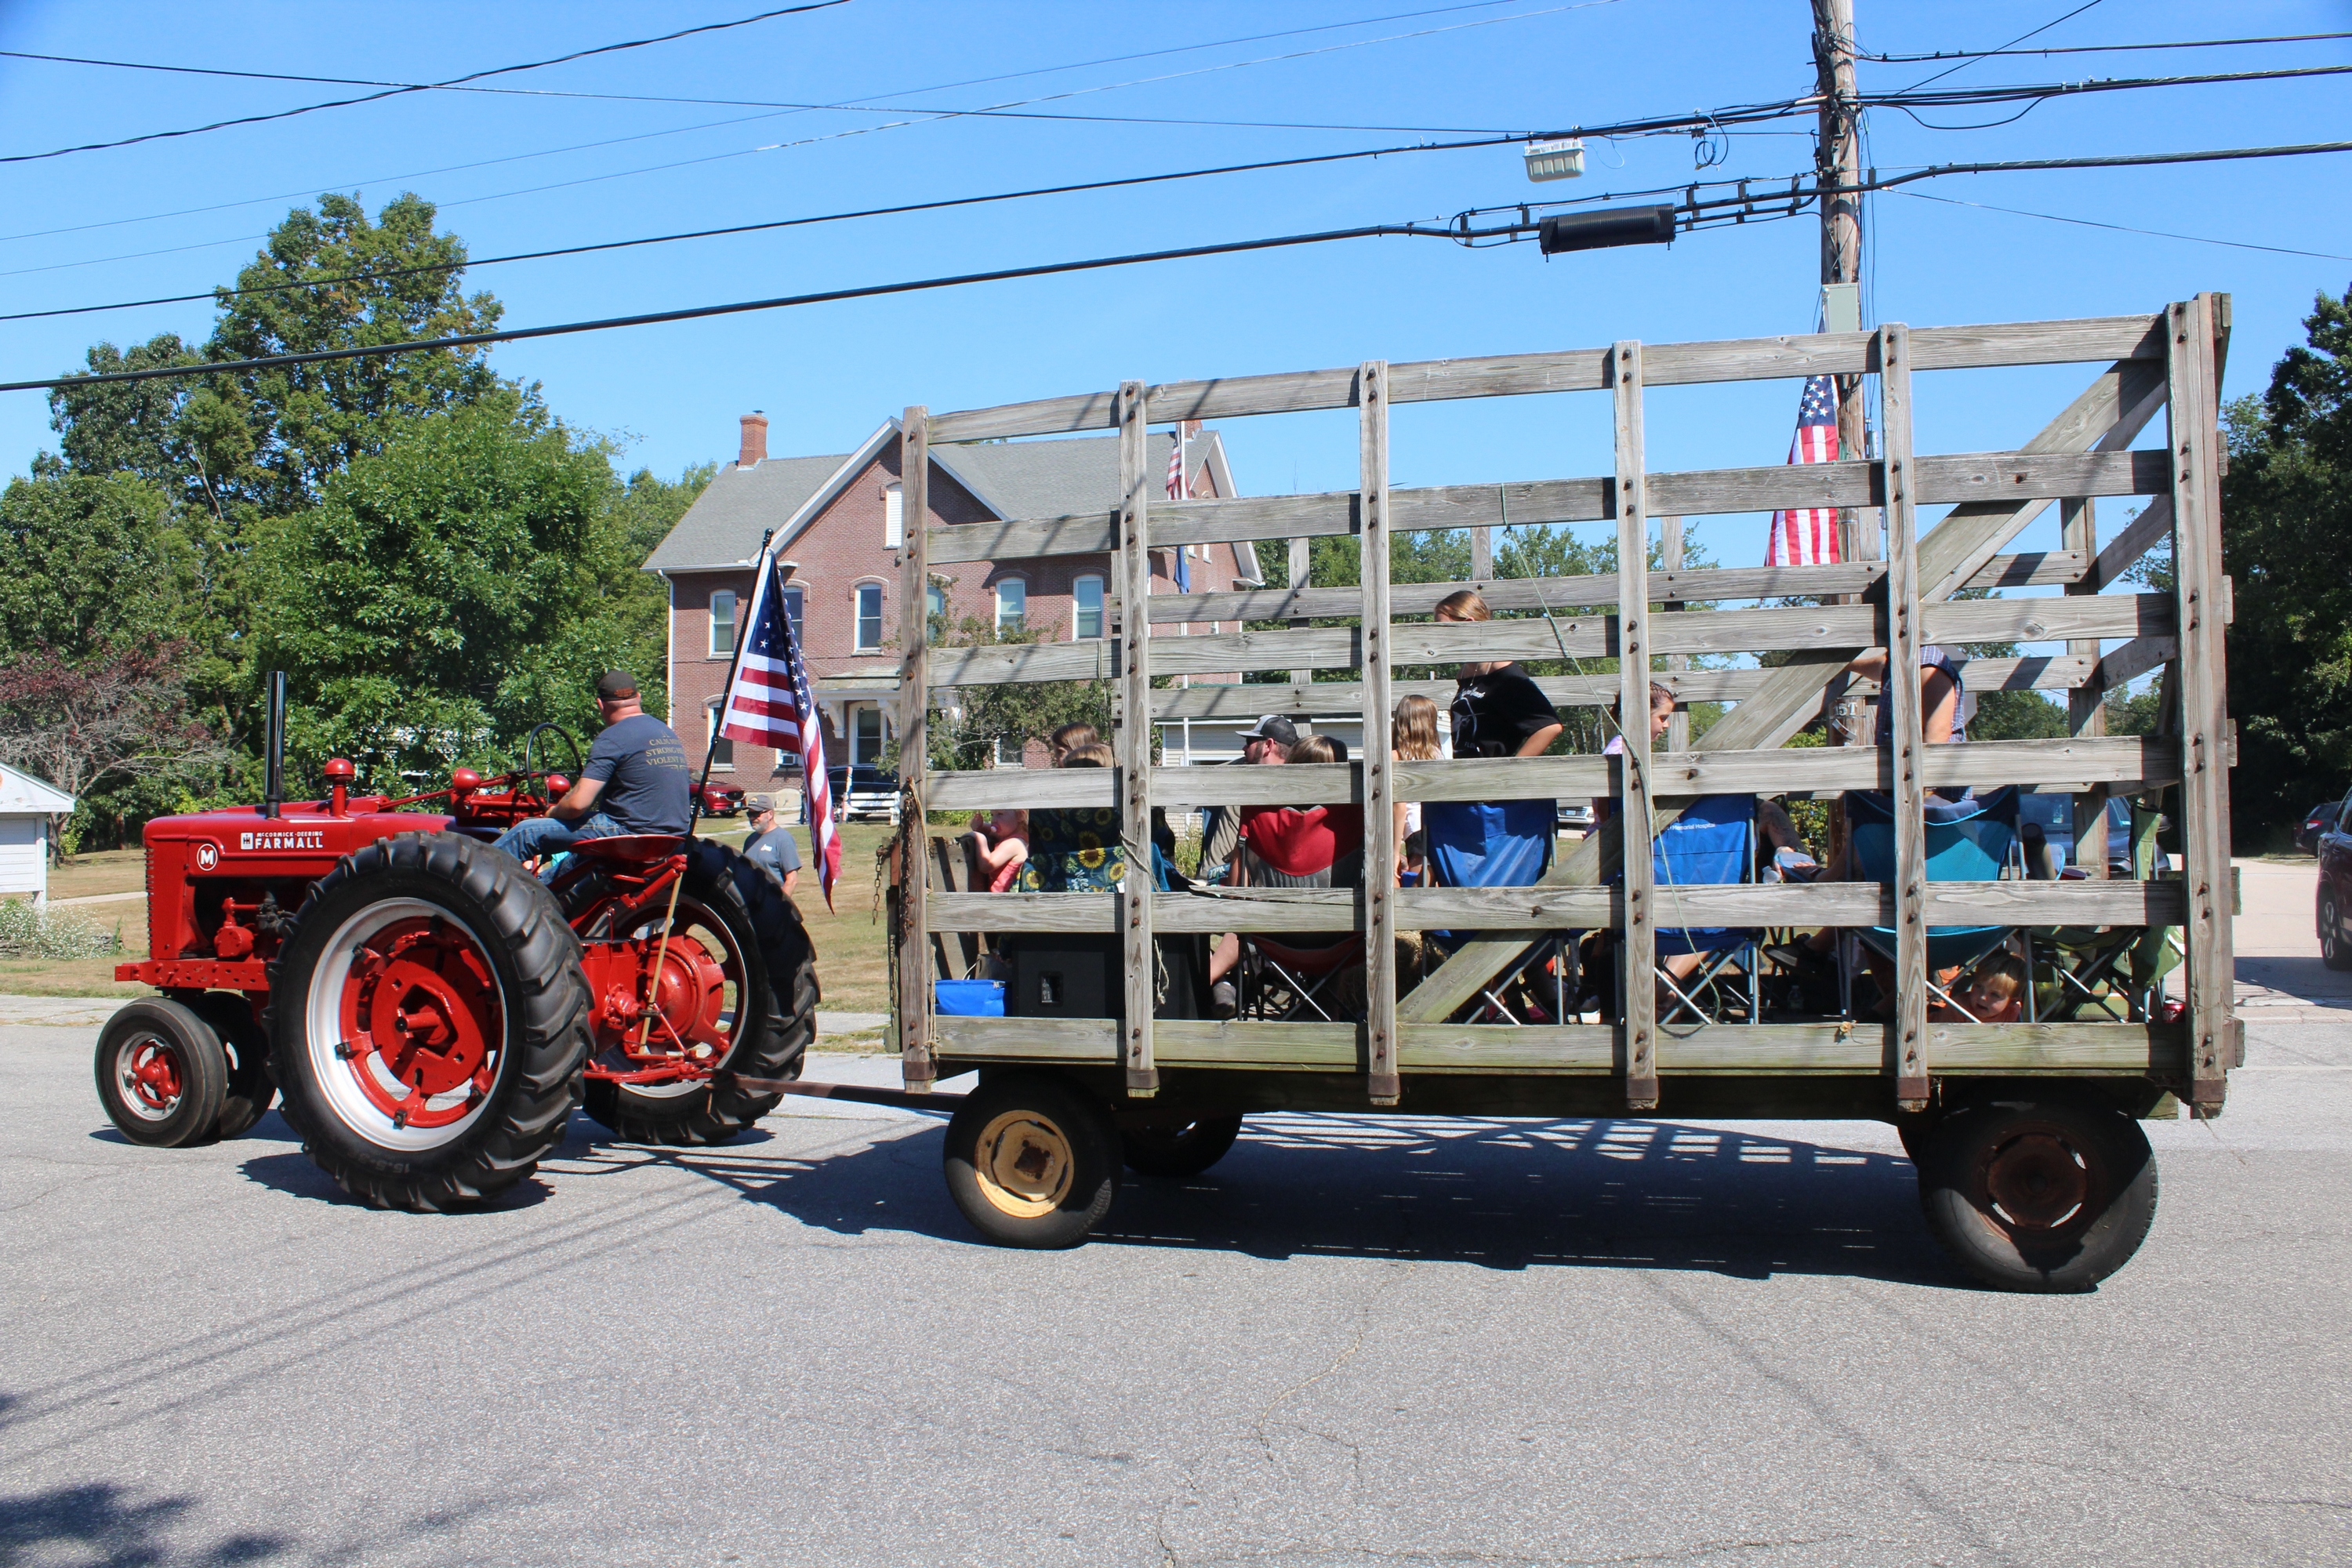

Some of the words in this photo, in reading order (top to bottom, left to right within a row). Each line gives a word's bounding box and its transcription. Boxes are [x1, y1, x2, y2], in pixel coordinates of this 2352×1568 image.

[645, 747, 676, 757] STRONG
[646, 756, 679, 765] VIOLENT
[255, 837, 324, 849] FARMALL
[200, 849, 214, 866] M
